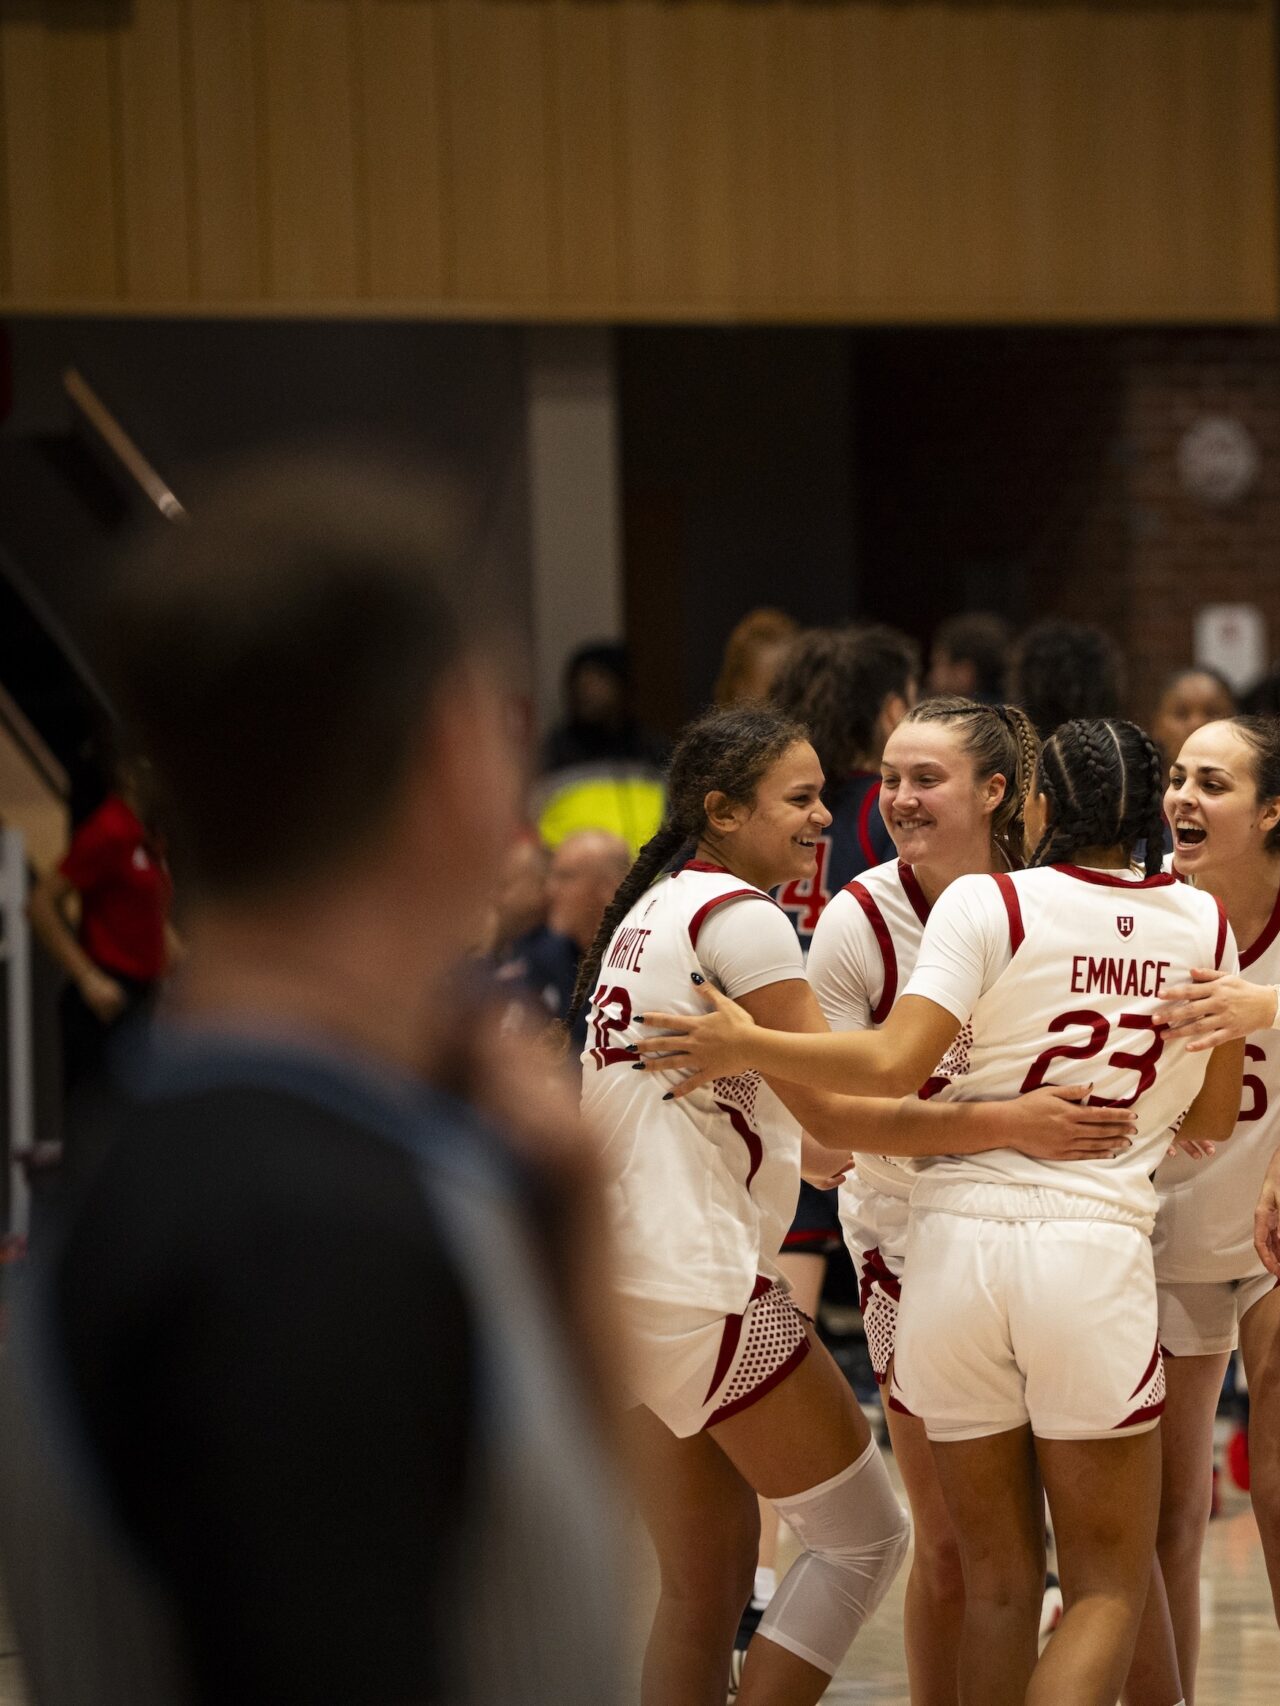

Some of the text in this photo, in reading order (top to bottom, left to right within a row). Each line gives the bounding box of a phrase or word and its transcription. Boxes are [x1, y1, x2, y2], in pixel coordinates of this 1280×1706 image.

[607, 927, 651, 974] WHITE
[1071, 955, 1171, 998] EMNACE
[589, 984, 641, 1071] 12
[1019, 1009, 1170, 1109] 23
